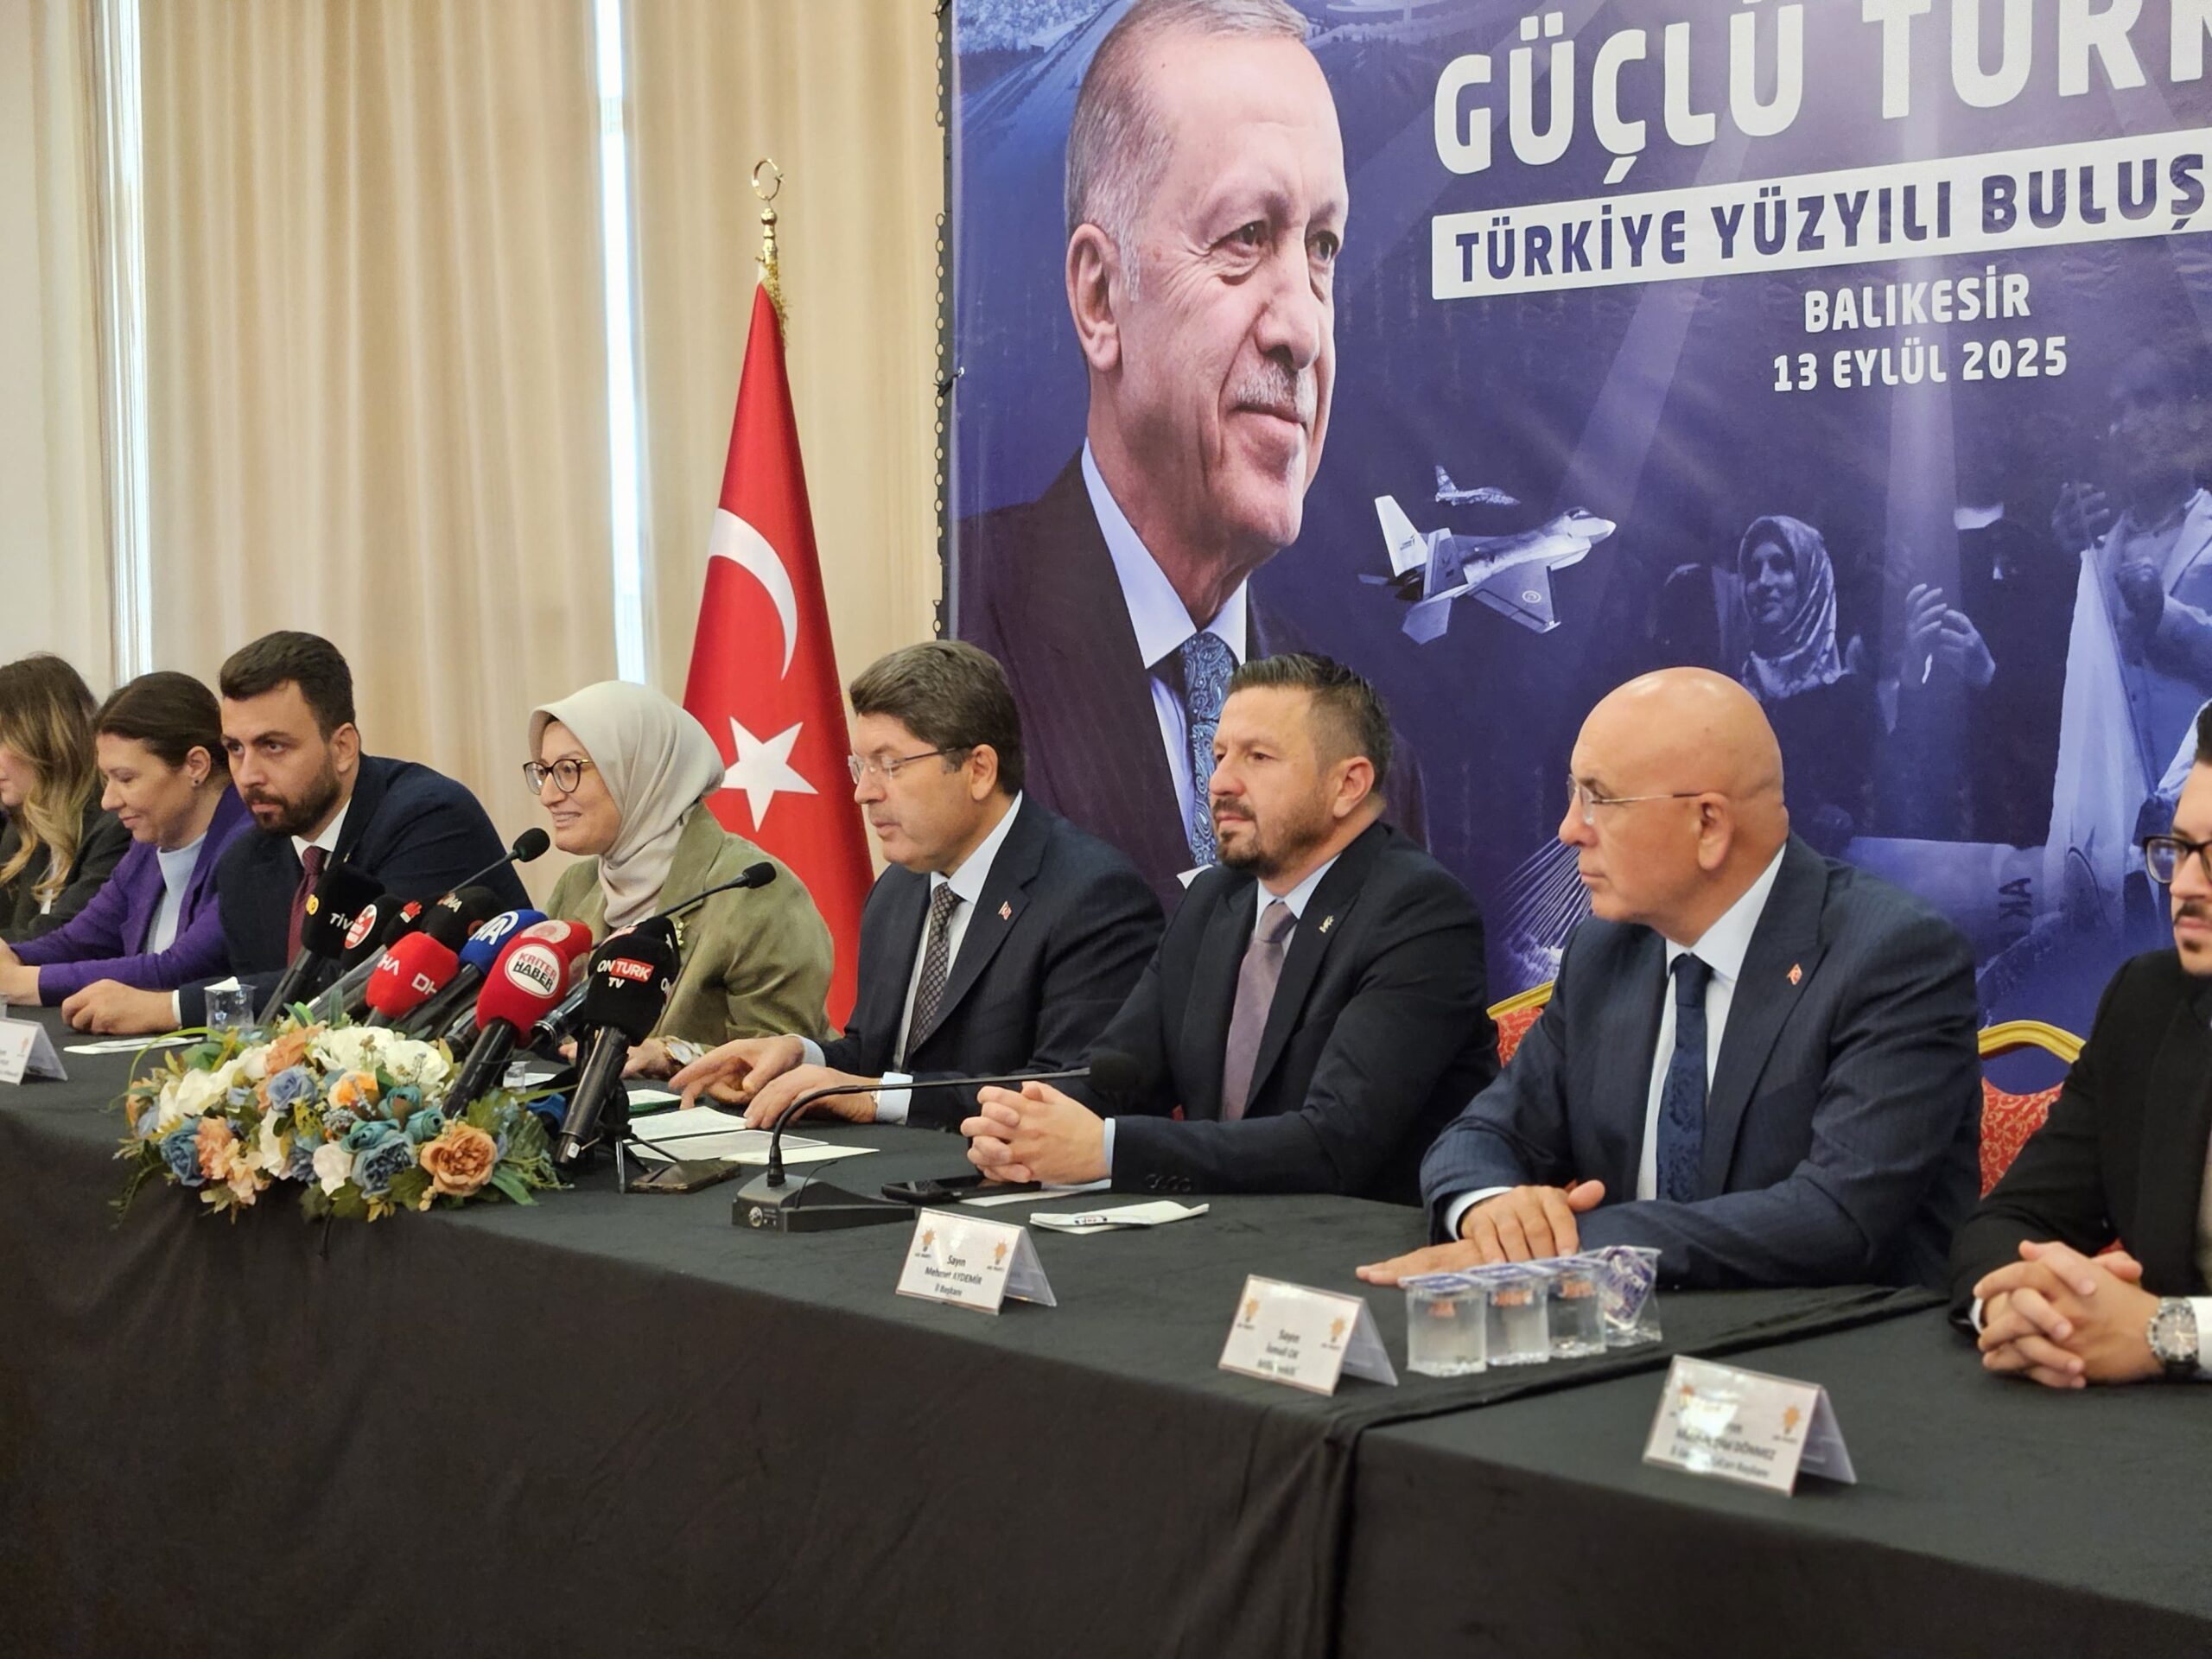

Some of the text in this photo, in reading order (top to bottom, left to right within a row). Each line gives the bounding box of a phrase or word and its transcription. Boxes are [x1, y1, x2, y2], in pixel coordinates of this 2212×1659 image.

[1434, 0, 1804, 184] GÜÇLÜ
[1455, 153, 2205, 283] TÜRKİYE YÜZYILI BULUŞ
[1805, 264, 2031, 333] BALIKESİR
[1774, 336, 2067, 391] 13 EYLÜL 2025
[512, 961, 554, 992] HABER
[608, 976, 625, 988] TV
[925, 1267, 951, 1279] Mehmet
[947, 1255, 966, 1267] Sayın
